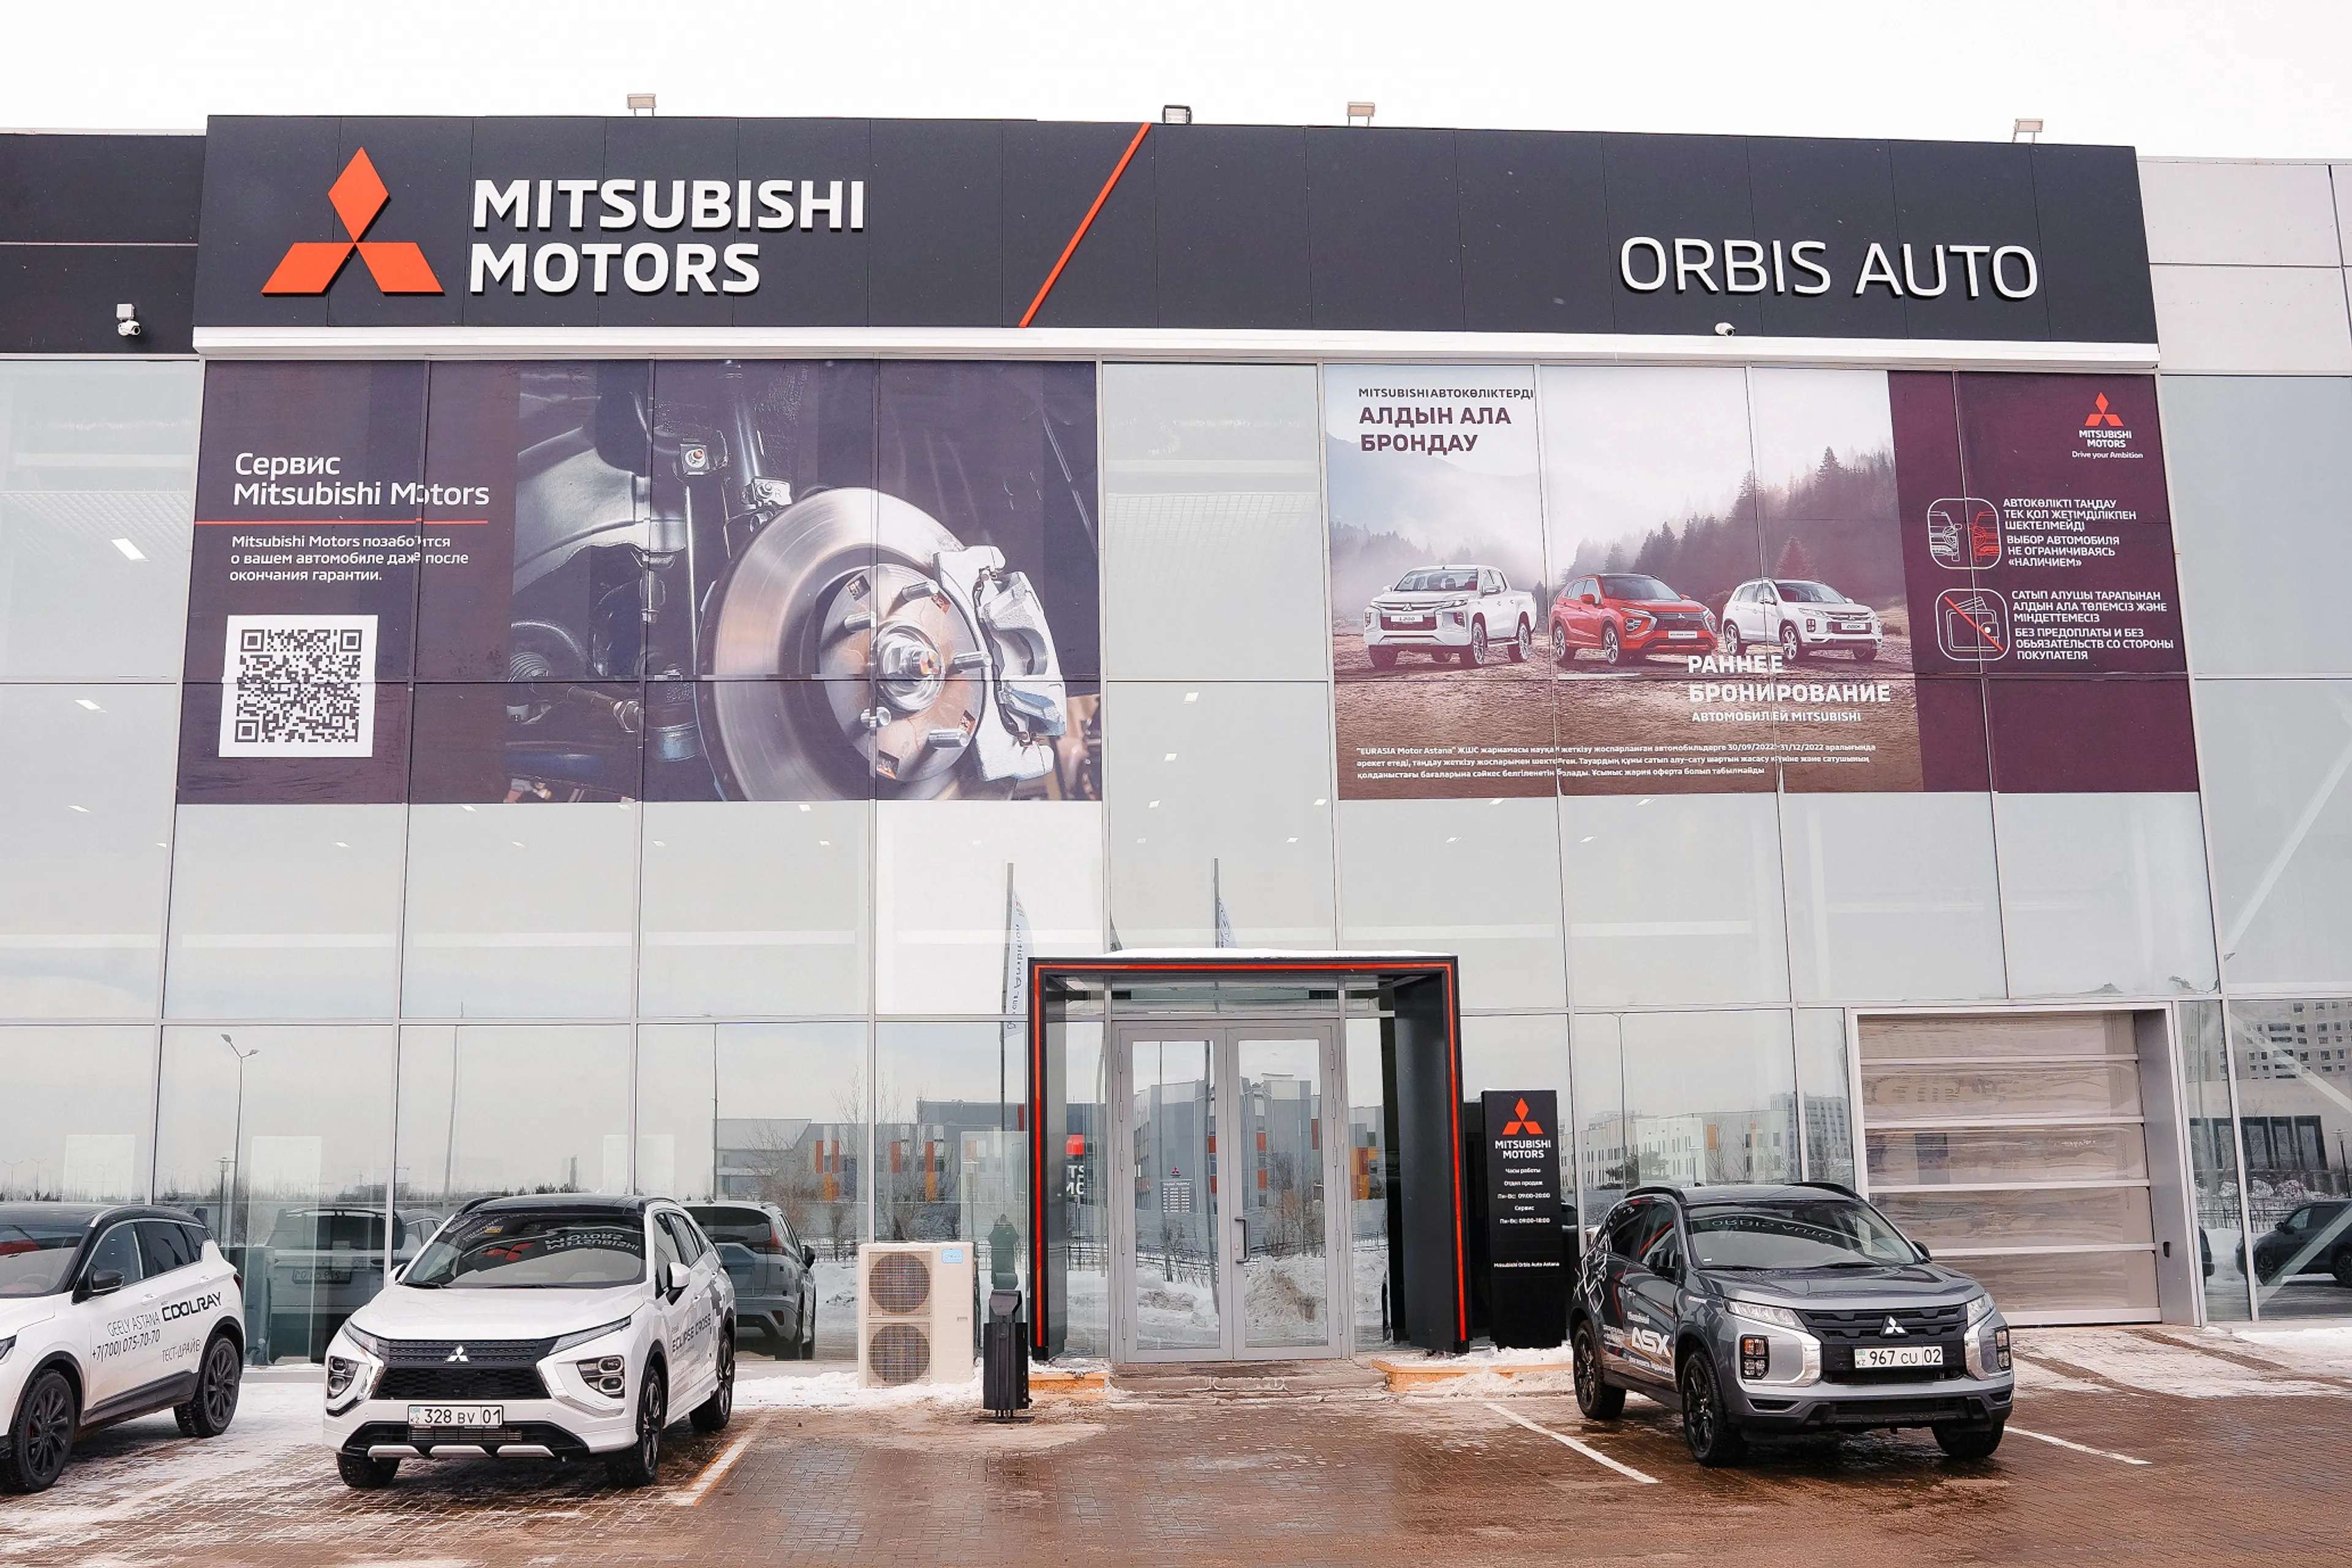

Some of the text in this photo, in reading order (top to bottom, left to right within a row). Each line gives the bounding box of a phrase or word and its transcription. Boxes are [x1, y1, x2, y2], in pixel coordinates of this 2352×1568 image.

[472, 179, 864, 230] MITSUBISHI
[469, 242, 760, 294] MOTORS
[1620, 236, 2038, 298] ORBIS AUTO
[1359, 407, 1512, 428] АЛДЫН АЛА
[2079, 430, 2132, 439] MITSUBISHI
[1360, 434, 1478, 456] БРОНДАУ
[2087, 439, 2126, 448] MOTORS
[235, 453, 341, 480] Сервис
[233, 481, 490, 506] Mitsubishi Motors
[2003, 499, 2117, 510] АВТОКӨЛІКТІ ТАҢДАУ
[2004, 510, 2136, 520] ТЕК ҚОЛ ЖЕТІМДІЛІКПЕН
[2005, 519, 2085, 532] ШЕКТЕЛМЕЙДІ
[232, 535, 305, 548] Mitsubishi
[309, 535, 360, 548] Motors
[2007, 535, 2120, 545] ВЫБОР АВТОМОБИЛЯ
[2008, 546, 2116, 556] НЕ ОГРАНИЧИВАЯСЬ
[230, 551, 469, 565] о вашем автомобиле даже после
[2008, 557, 2082, 567] «НАЛИЧИЕМ»
[230, 570, 382, 583] окончания гарантии.
[2011, 590, 2161, 600] САТЫП АЛУШЫ ТАРАПЫНАН
[2013, 602, 2168, 612] АЛДЫН АЛА ТӨЛЕМСІЗ ЖӘНЕ
[2014, 613, 2100, 624] МІНДЕТТЕМЕСІЗ
[2015, 628, 2144, 639] БЕЗ ПРЕДОПЛАТЫ И БЕЗ
[2106, 639, 2121, 648] СО
[2123, 639, 2174, 649] СТОРОНЫ
[2017, 650, 2089, 660] ПОКУПАТЕЛЯ
[1687, 655, 1784, 673] РАННЕЕ
[1689, 684, 1891, 703] БРОНИРОВАНИЕ
[1692, 710, 1861, 722] АВТОМОБИЛЕЙ MITSUBISHI
[1653, 768, 1683, 777] оферта
[1495, 1140, 1551, 1149] MITSUBISHI
[1502, 1150, 1545, 1159] MOTORS
[107, 1311, 161, 1337] GEELY ASTANA
[1631, 1327, 1673, 1359] ASX
[1869, 1349, 1941, 1365] 967 CU 02
[424, 1409, 501, 1424] 328 BV 01
